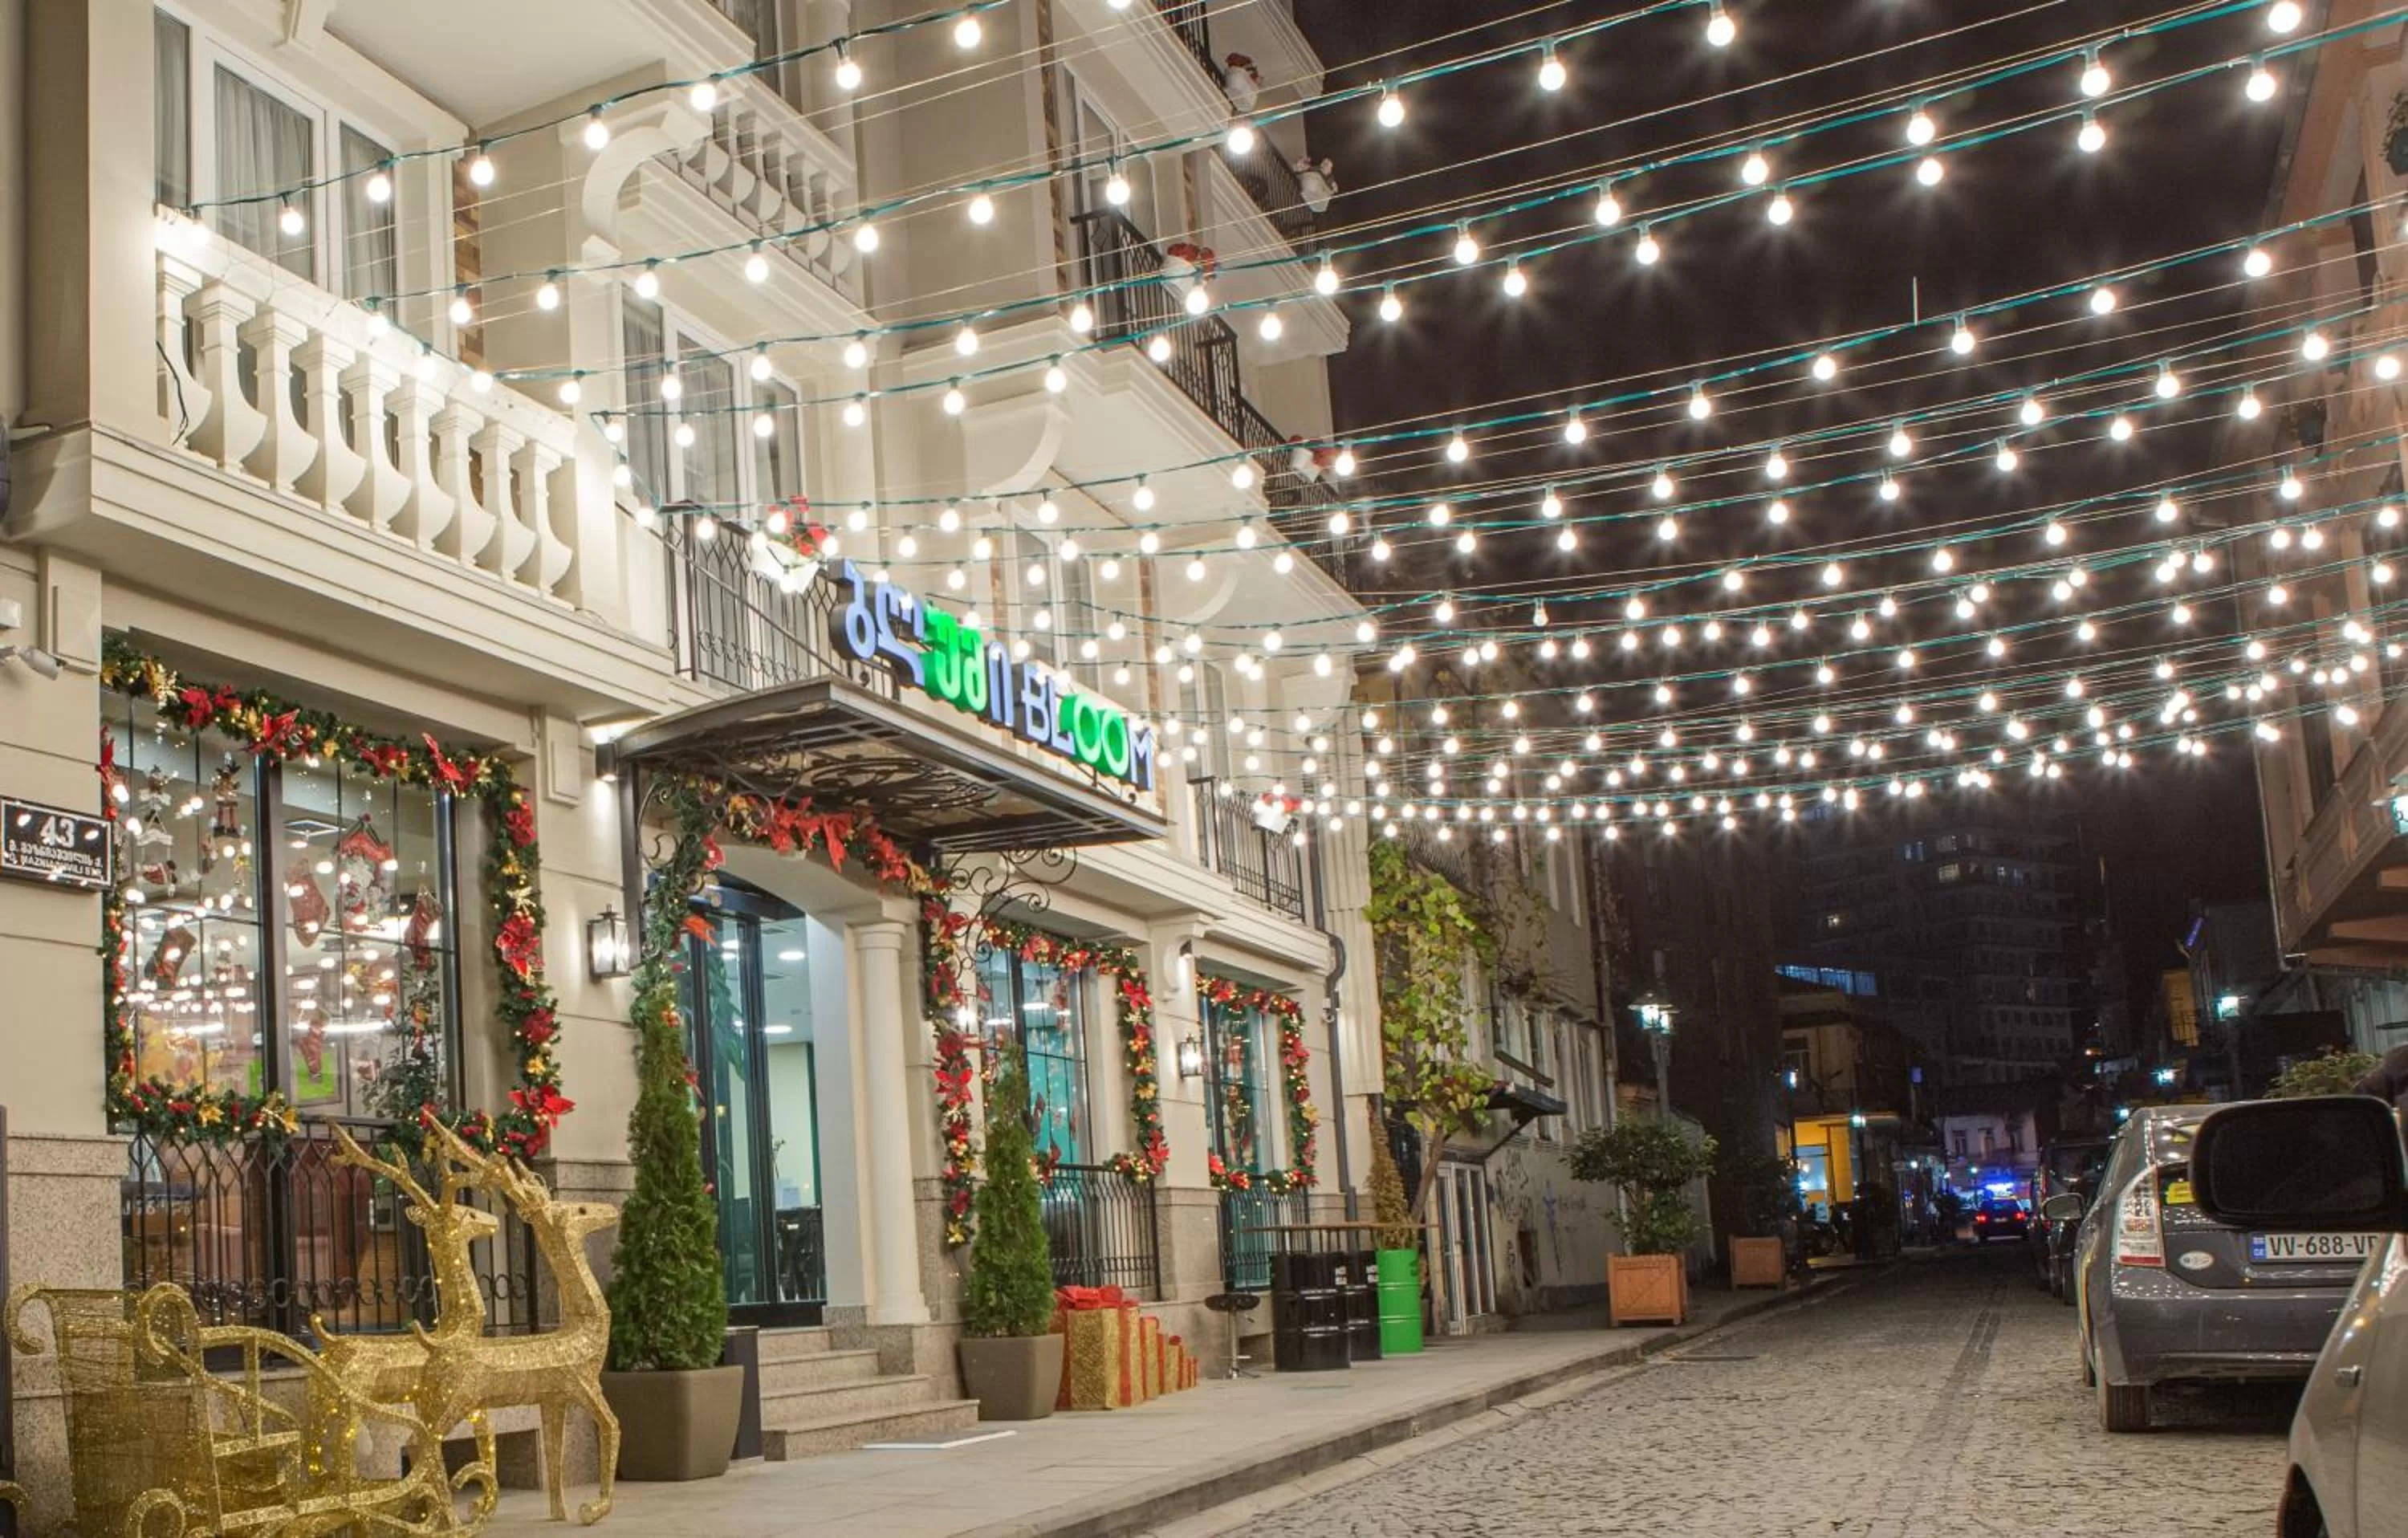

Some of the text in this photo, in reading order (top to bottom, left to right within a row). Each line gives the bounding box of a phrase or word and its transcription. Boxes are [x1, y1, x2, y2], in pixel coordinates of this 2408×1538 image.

[843, 559, 1153, 791] ბლუმი BLOOM
[40, 816, 75, 848] 43
